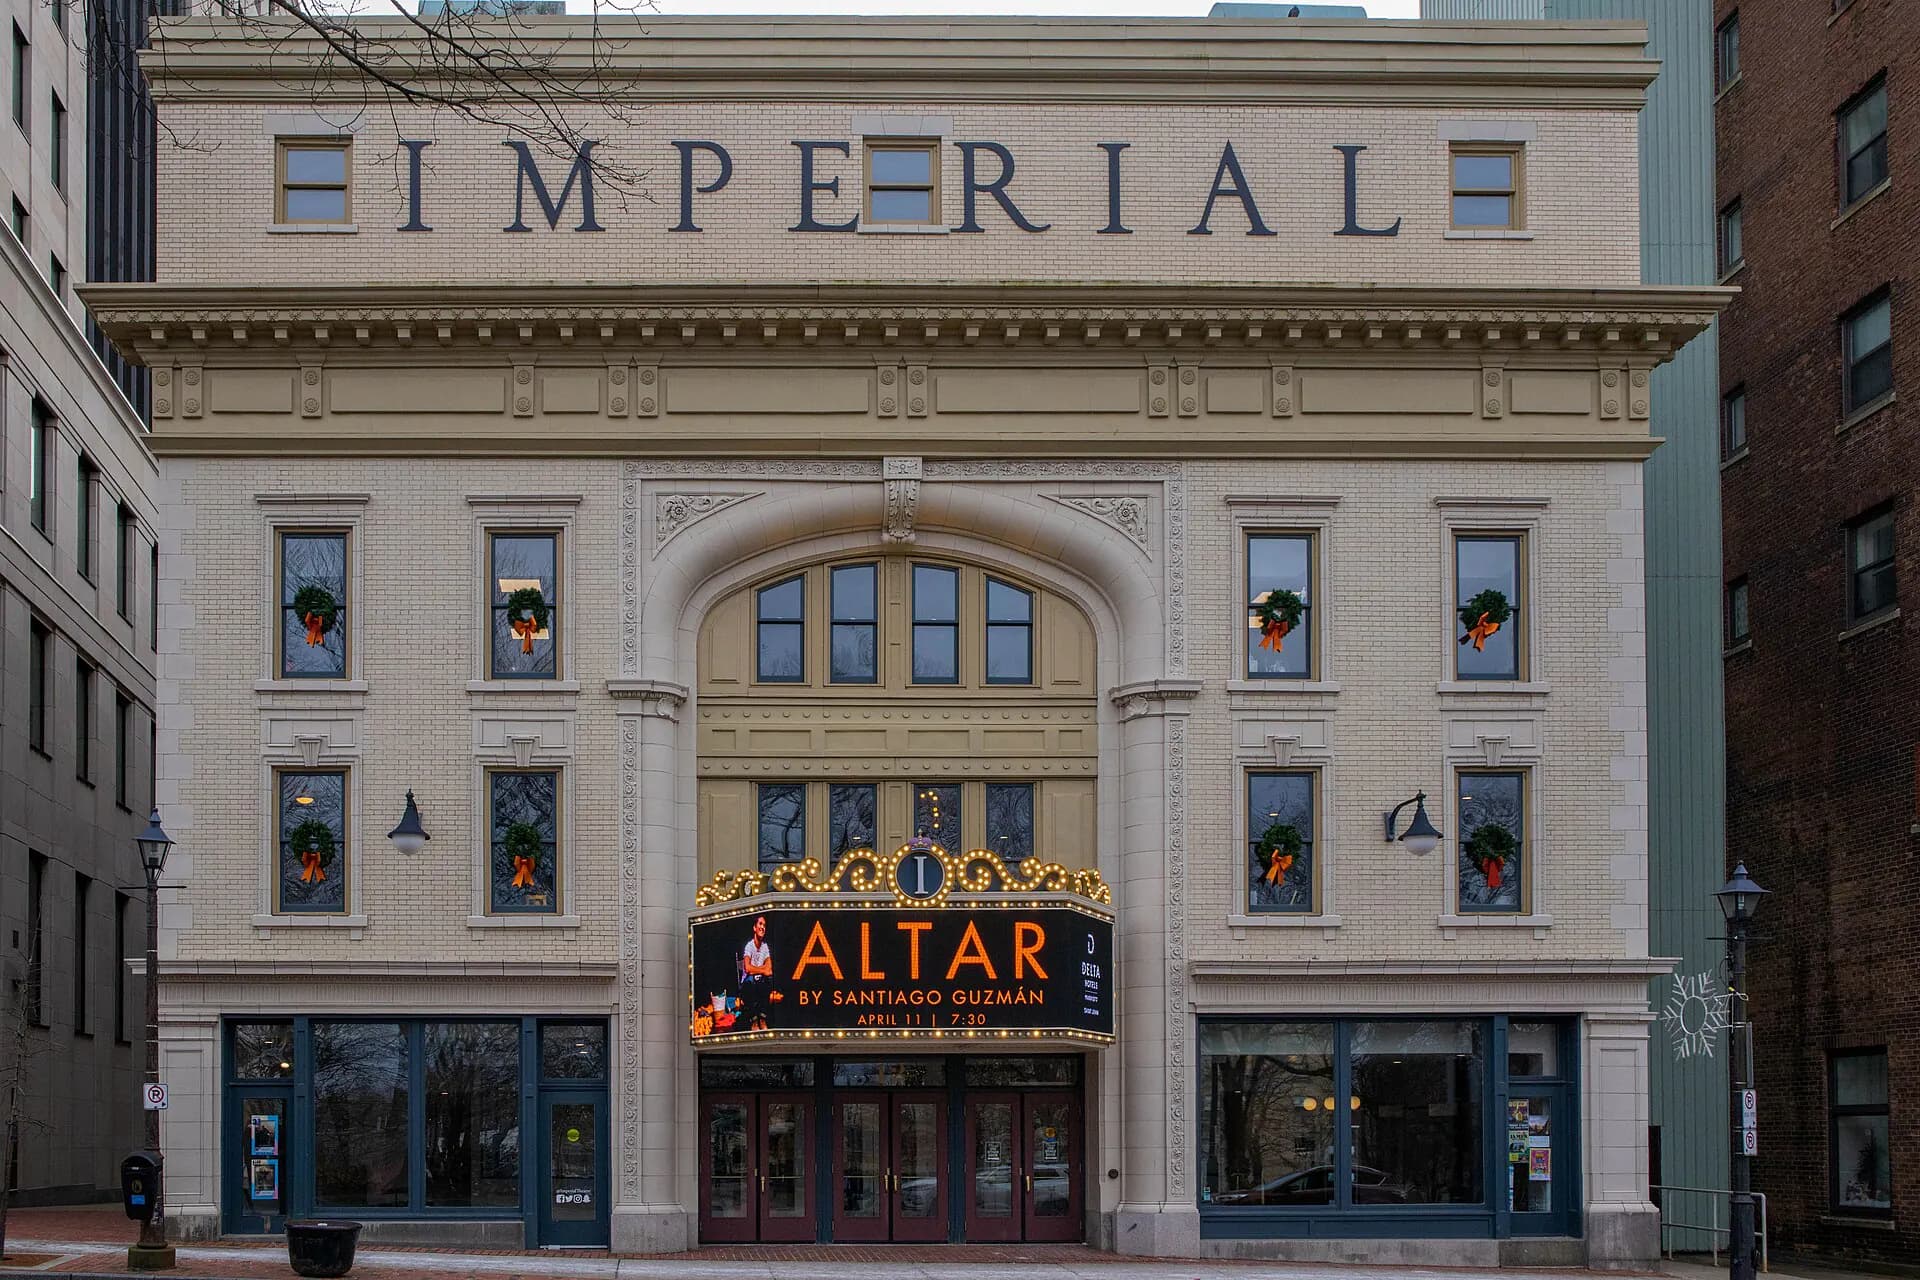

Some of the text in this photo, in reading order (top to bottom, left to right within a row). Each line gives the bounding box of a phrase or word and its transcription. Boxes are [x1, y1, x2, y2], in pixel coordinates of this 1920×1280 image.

[397, 139, 1401, 237] IMPERIAL
[791, 920, 1049, 980] ALTAR
[1081, 961, 1100, 979] DELTA
[800, 986, 1044, 1005] BY SANTIAGO GUZMÁN
[857, 1013, 987, 1025] APRIL 11 7:30
